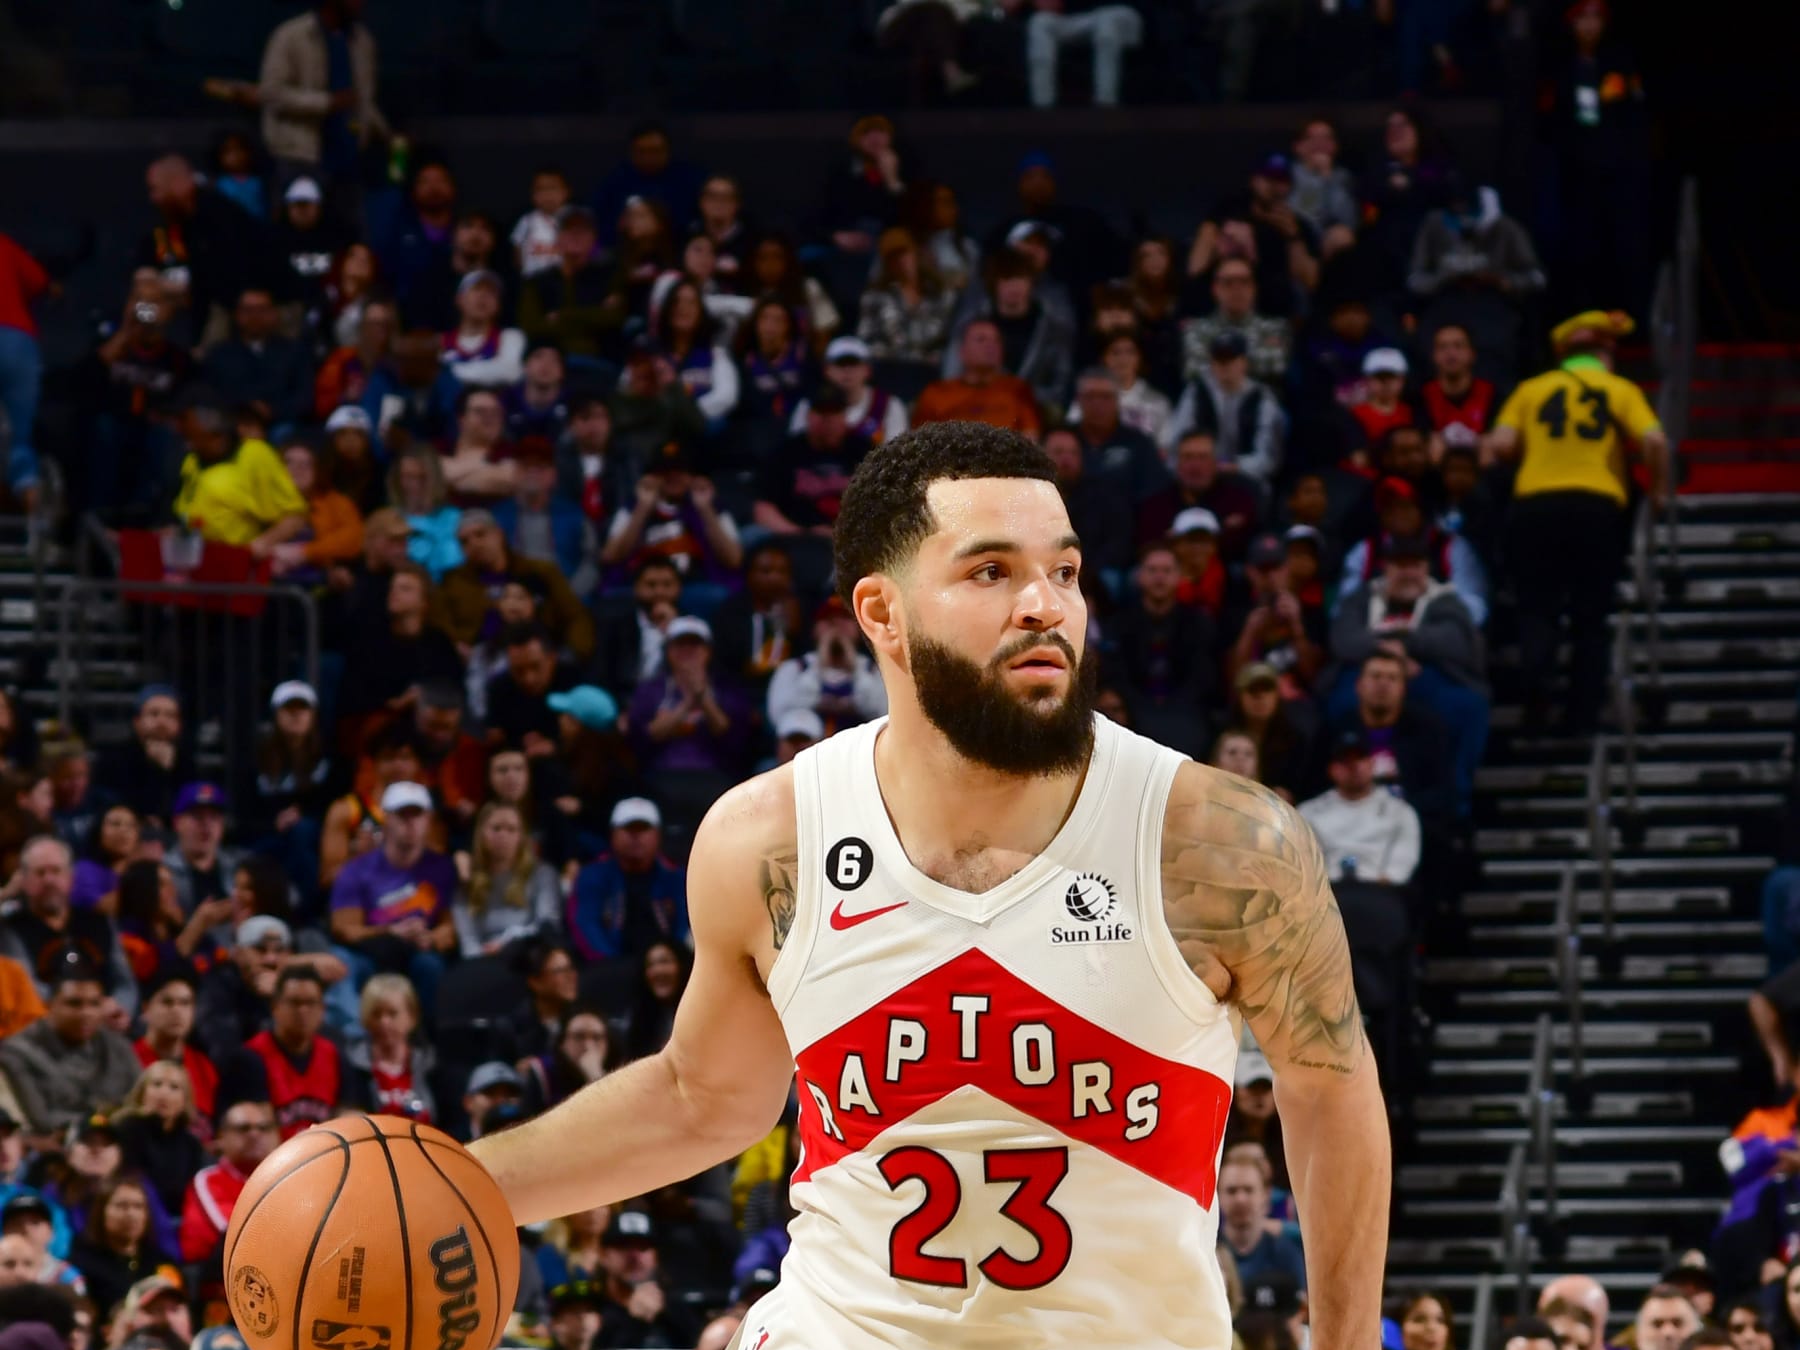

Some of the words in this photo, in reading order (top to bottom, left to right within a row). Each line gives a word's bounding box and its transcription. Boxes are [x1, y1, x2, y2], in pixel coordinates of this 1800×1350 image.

[1538, 386, 1608, 441] 43
[836, 844, 861, 886] 6
[1051, 926, 1090, 944] Sun
[1095, 922, 1133, 941] Life
[805, 993, 1160, 1142] RAPTORS
[876, 1145, 1073, 1291] 23
